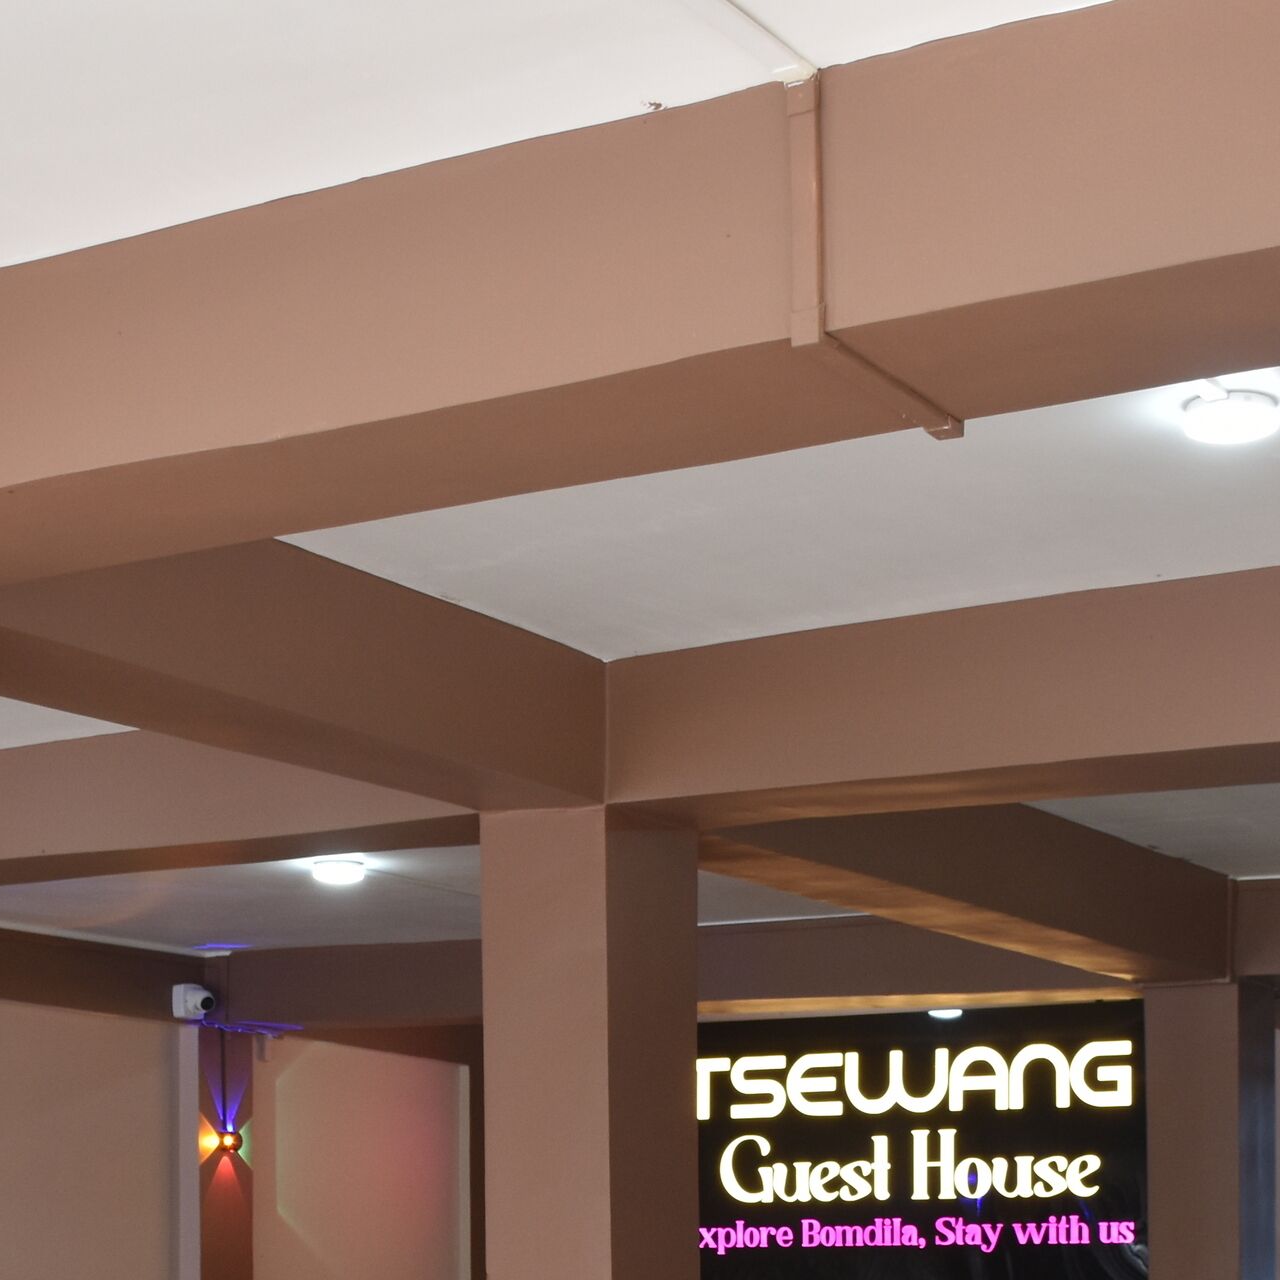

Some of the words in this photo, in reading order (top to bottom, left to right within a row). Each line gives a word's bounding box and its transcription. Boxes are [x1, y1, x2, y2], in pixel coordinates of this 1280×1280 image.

[719, 1134, 892, 1204] Guest
[910, 1128, 1102, 1201] House
[698, 1219, 794, 1256] xplore
[800, 1217, 927, 1249] Bomdila,
[934, 1216, 1004, 1253] Stay
[1011, 1214, 1091, 1245] with
[1097, 1219, 1136, 1245] us
